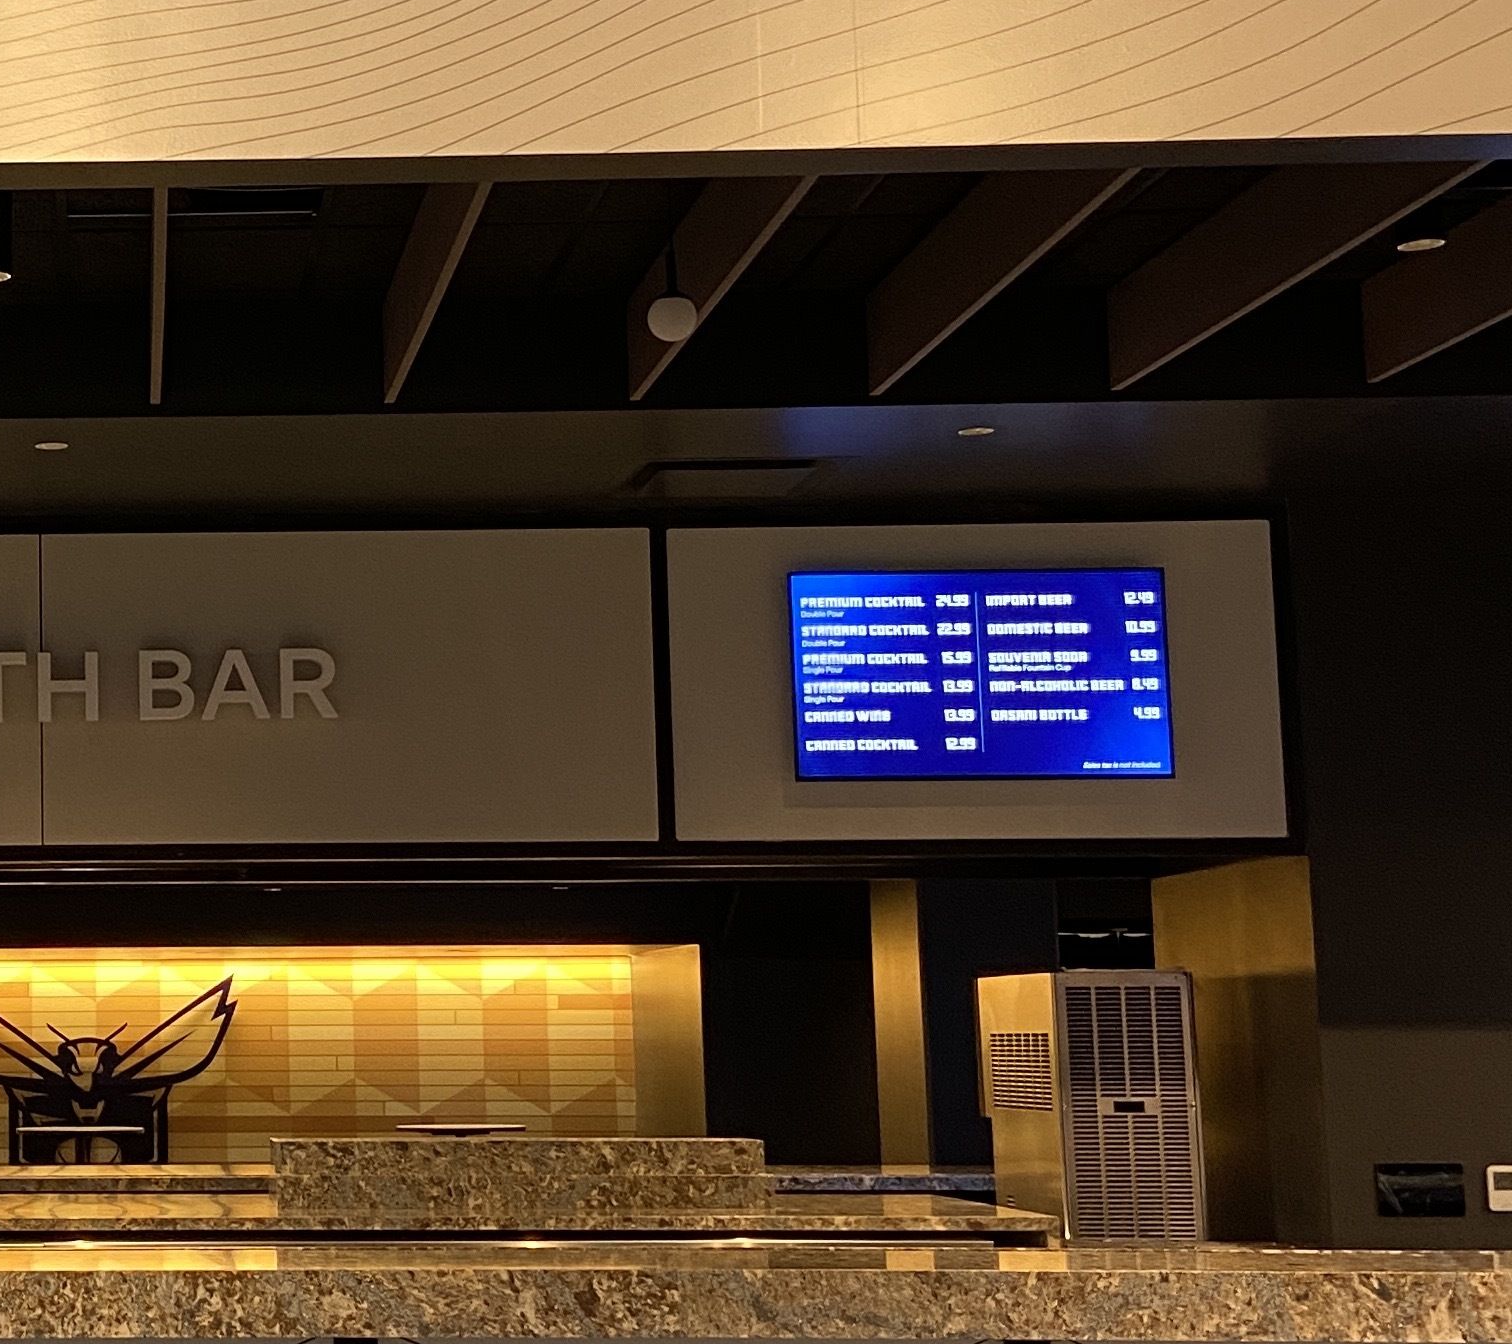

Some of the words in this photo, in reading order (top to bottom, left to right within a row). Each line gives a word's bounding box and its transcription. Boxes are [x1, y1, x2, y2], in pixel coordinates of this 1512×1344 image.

[800, 597, 862, 608] PREMIUM
[865, 596, 925, 607] COCKTAIL
[935, 595, 969, 607] 24.99
[985, 595, 1036, 606] IMPORT
[1038, 594, 1072, 606] BEER
[1123, 592, 1154, 604] 12.49
[801, 625, 866, 636] STANDARD
[869, 625, 929, 636] COCKTAIL
[937, 623, 971, 635] 22.99
[987, 623, 1053, 635] DOMESTIC
[1054, 623, 1088, 634] BEER
[1125, 620, 1156, 633] 10.99
[803, 654, 864, 665] PREMIUM
[867, 653, 928, 664] COCKTAIL
[941, 651, 972, 664] 15.99
[988, 652, 1052, 663] SOUVENIR
[1054, 651, 1088, 663] SODA
[1130, 649, 1158, 662] 9.99
[138, 647, 340, 721] BAR
[803, 682, 869, 694] STANDARD
[871, 681, 932, 693] COCKTAIL
[943, 680, 973, 693] 13.99
[989, 681, 1089, 693] NON-ALCOHOLIC
[1091, 680, 1124, 692] BEER
[1132, 678, 1158, 690] 8.49
[804, 711, 854, 722] CANNED
[856, 710, 891, 722] WINE
[944, 709, 975, 722] 13.99
[991, 710, 1037, 722] DASANI
[1039, 709, 1088, 721] BOTTLE
[1133, 707, 1160, 719] 4.99
[806, 740, 855, 751] CANNED
[857, 739, 919, 751] COCKTAIL
[945, 737, 976, 750] 12.99
